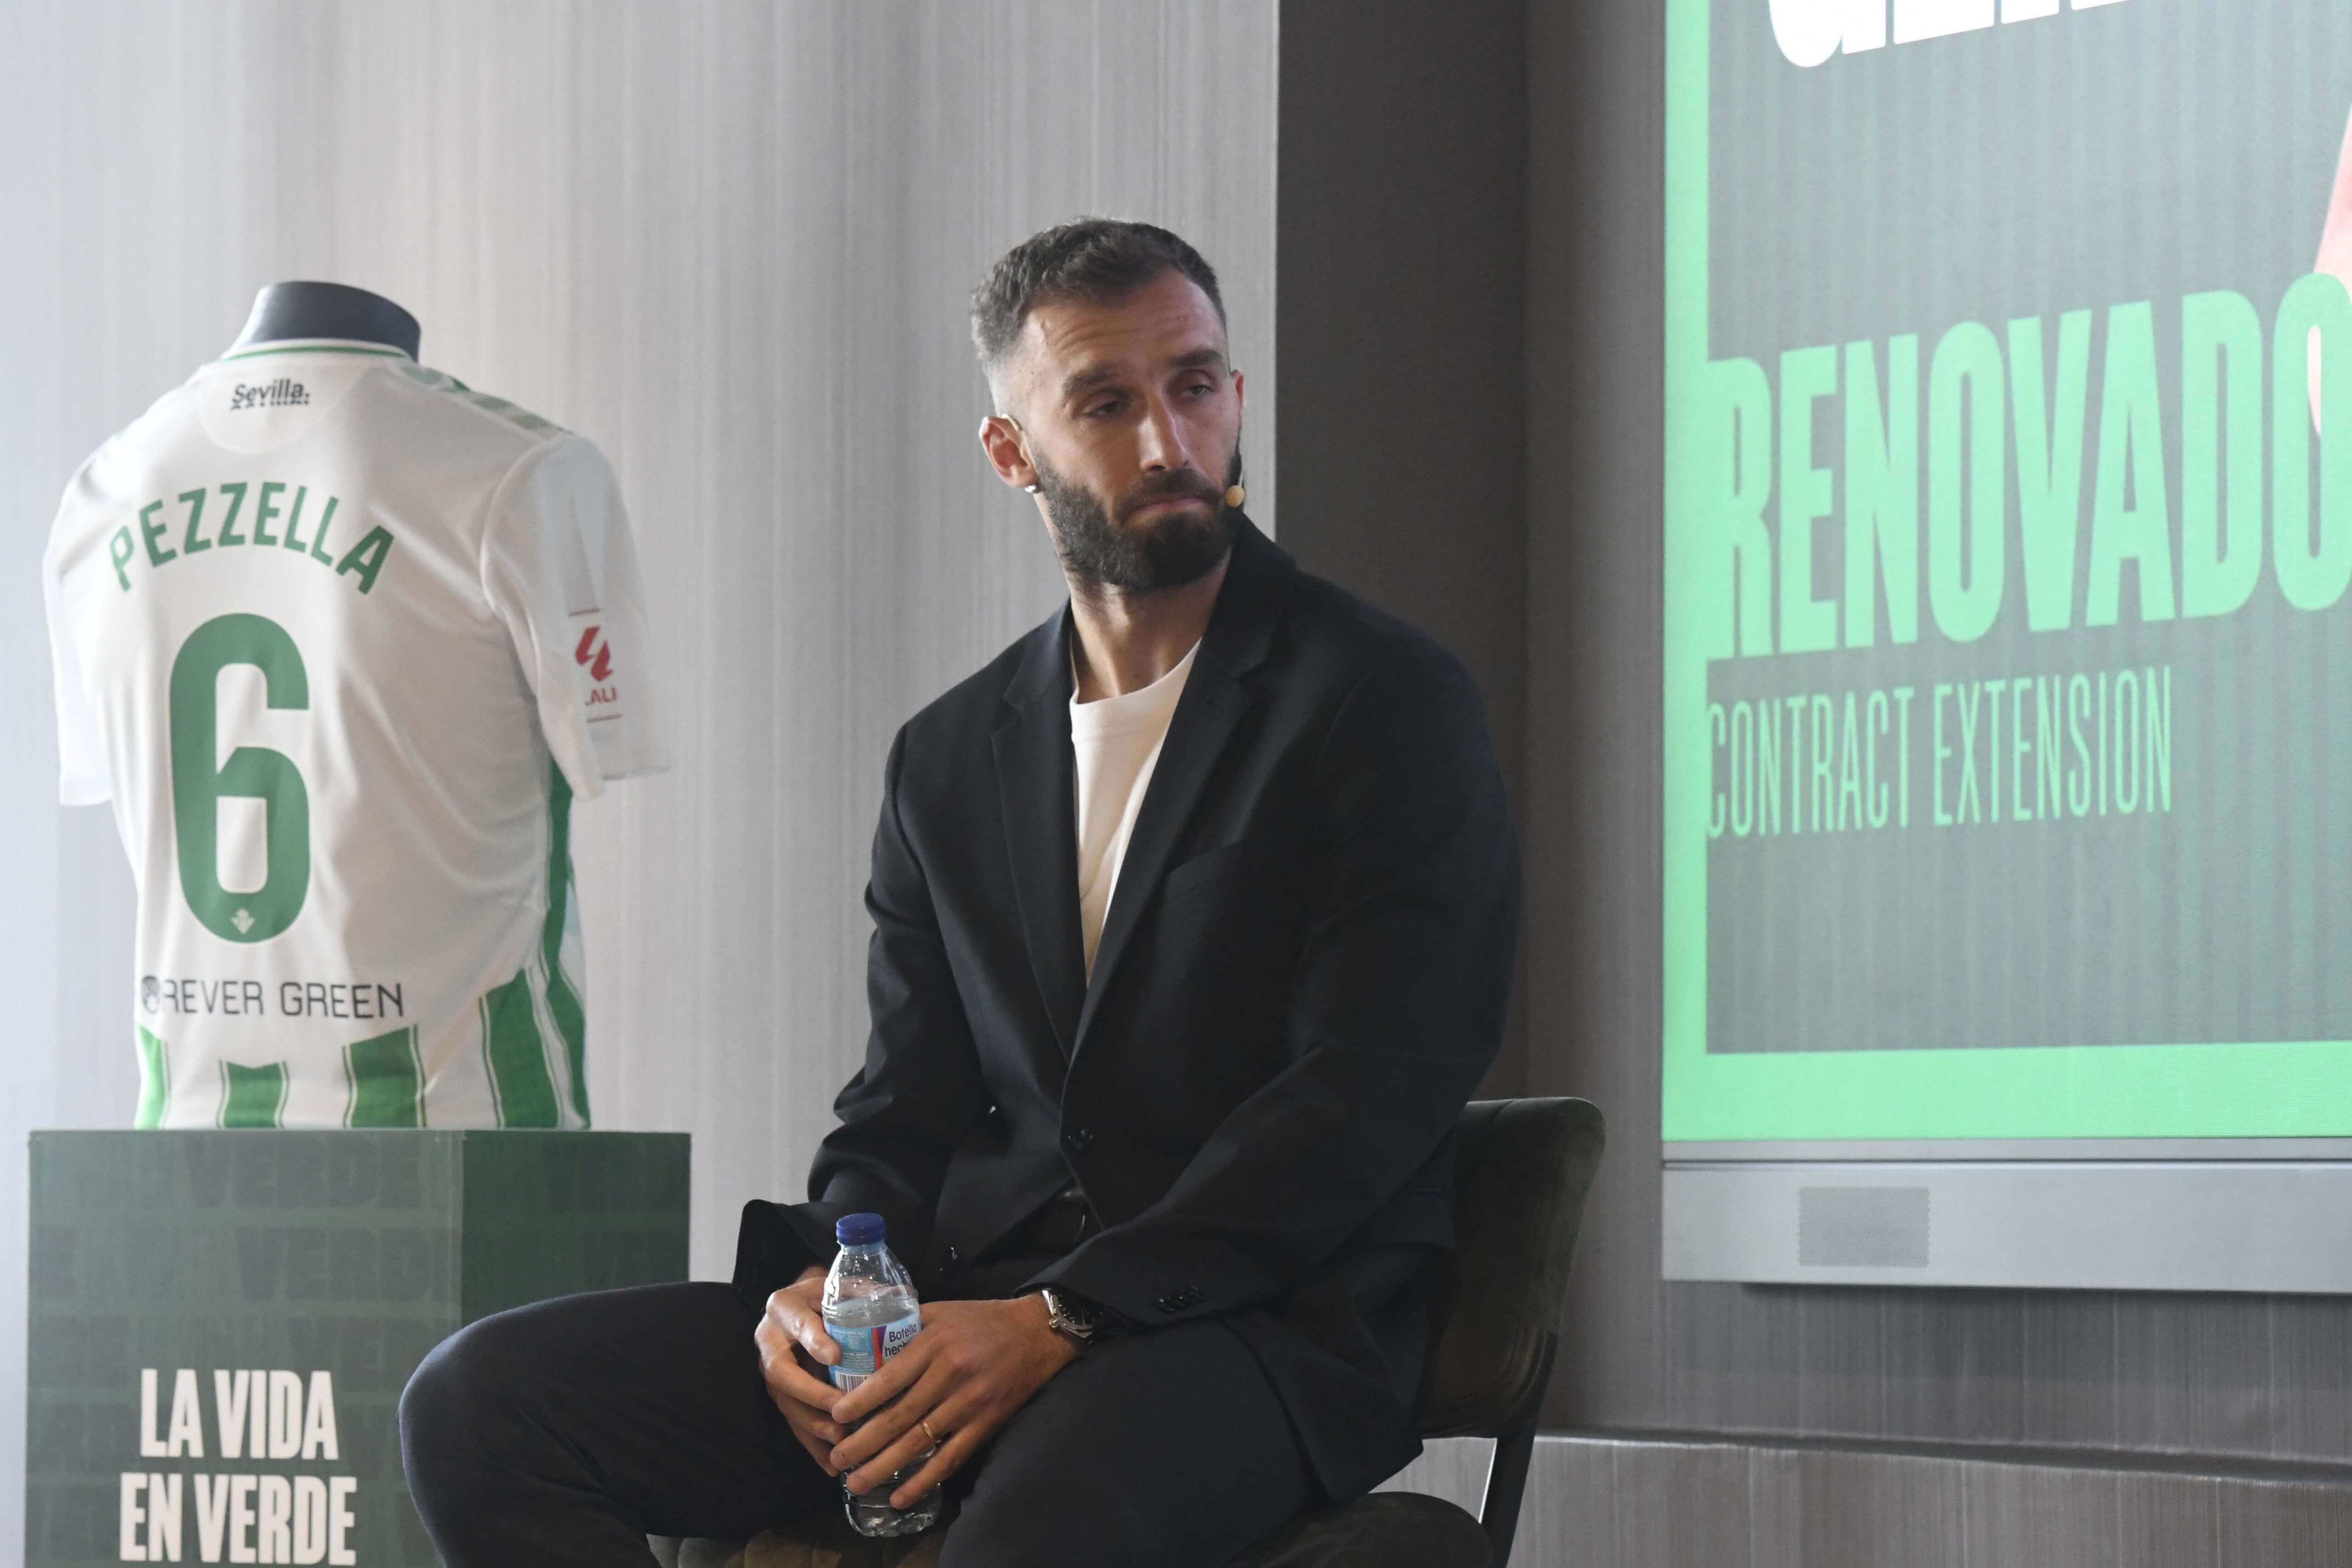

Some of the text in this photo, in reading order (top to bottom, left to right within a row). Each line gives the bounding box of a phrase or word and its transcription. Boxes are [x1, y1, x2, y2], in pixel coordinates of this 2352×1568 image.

[1706, 272, 2352, 661] RENOVADO
[109, 481, 395, 594] PEZZELLA
[170, 612, 311, 943] 6
[1706, 664, 2171, 839] CONTRACT EXTENSION
[280, 972, 404, 1019] GREEN
[888, 1324, 917, 1342] Botella
[141, 1368, 204, 1458] LA
[214, 1369, 339, 1460] VIDA
[119, 1472, 183, 1562] EN
[193, 1473, 357, 1566] VERDE
